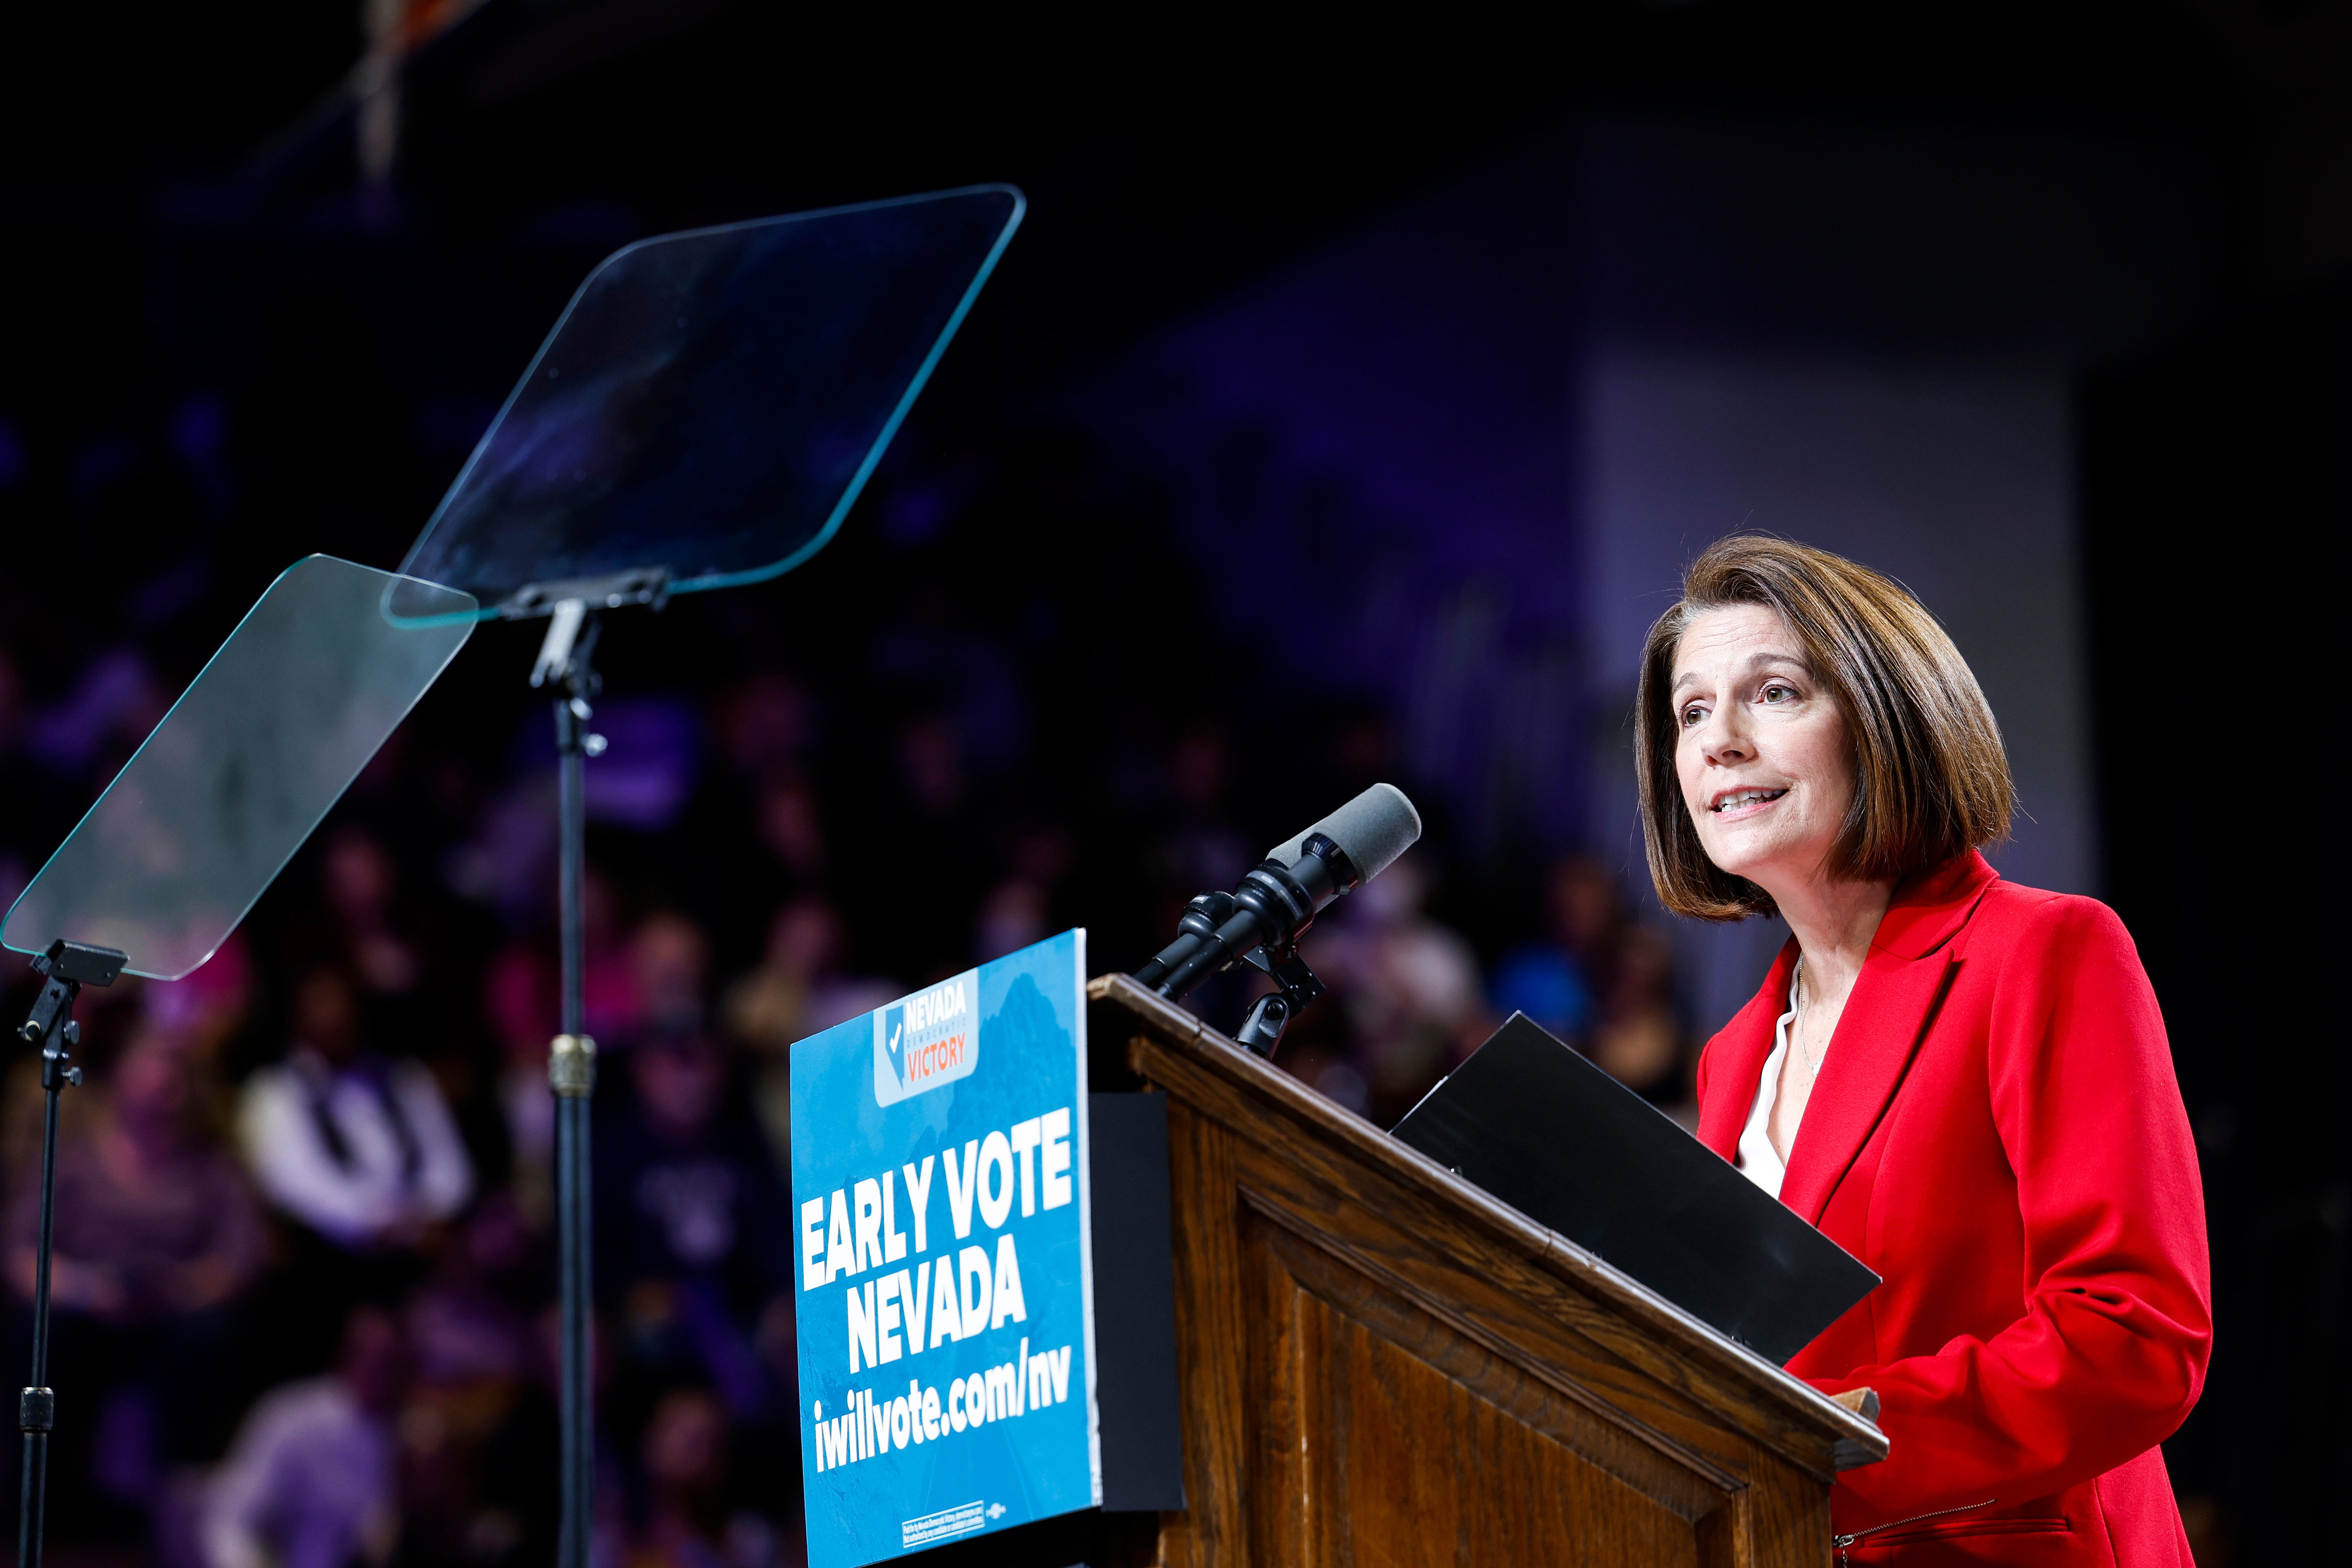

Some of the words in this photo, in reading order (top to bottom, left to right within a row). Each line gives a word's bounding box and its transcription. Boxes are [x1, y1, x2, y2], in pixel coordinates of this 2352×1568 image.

[906, 980, 966, 1034] NEVADA
[907, 1032, 965, 1082] VICTORY
[801, 1155, 935, 1292] EARLY
[942, 1107, 1071, 1240] VOTE
[847, 1233, 1027, 1374] NEVADA
[814, 1337, 1071, 1473] iwillvote.com/nv
